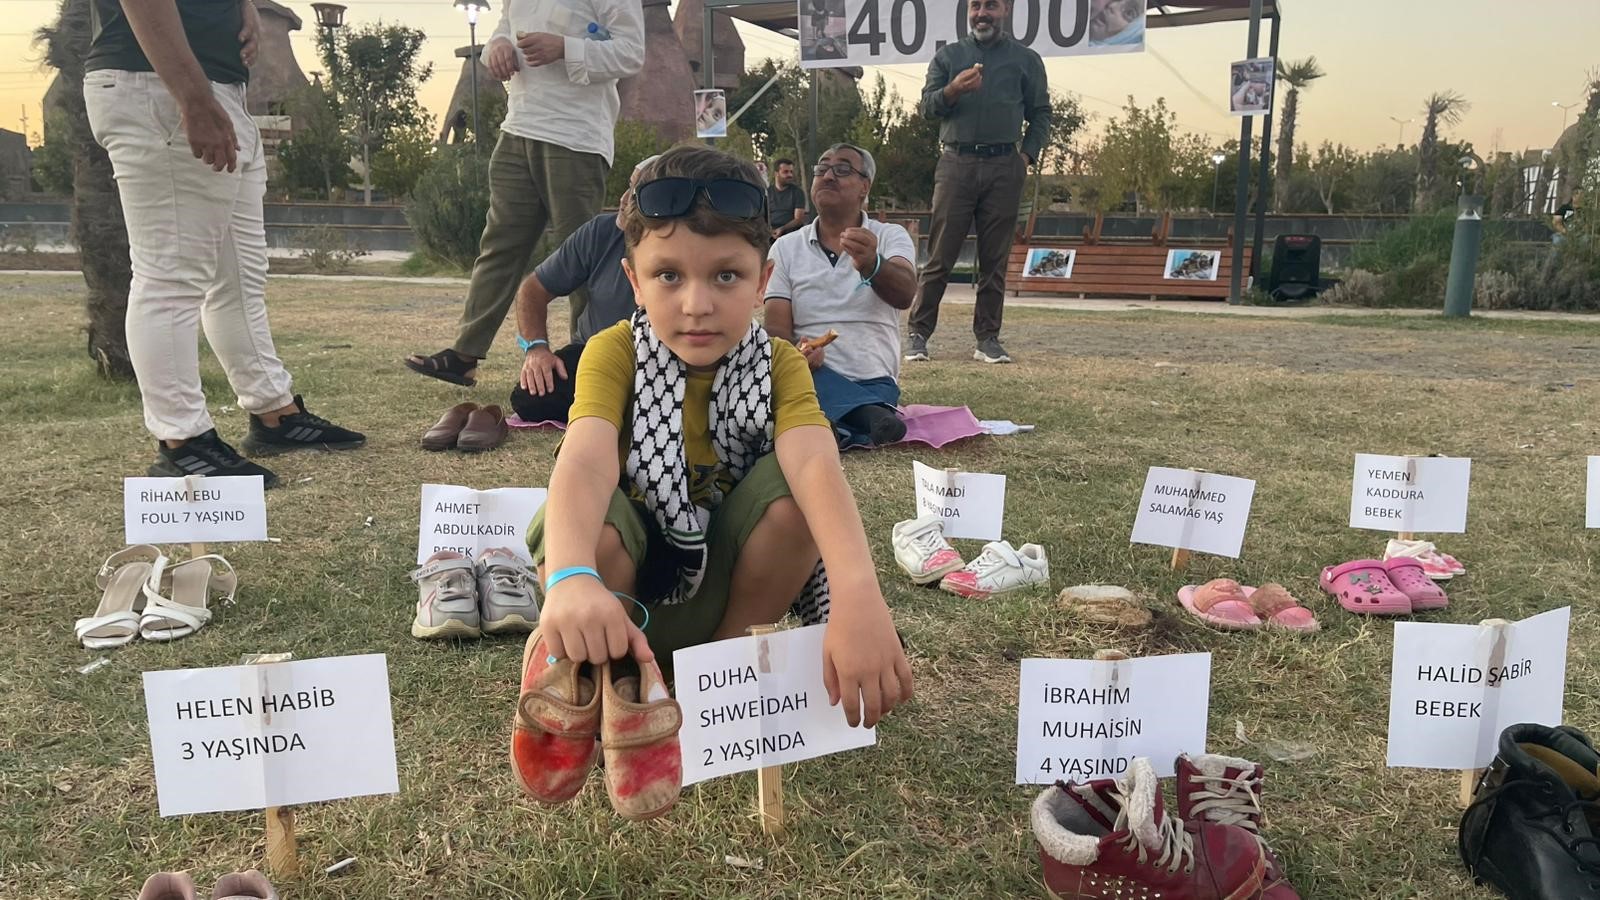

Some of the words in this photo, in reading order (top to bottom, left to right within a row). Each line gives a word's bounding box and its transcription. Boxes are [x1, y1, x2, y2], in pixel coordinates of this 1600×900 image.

[1368, 469, 1411, 482] YEMEN
[140, 488, 188, 503] RİHAM
[193, 489, 221, 501] EBU
[936, 485, 965, 498] MADİ
[1154, 484, 1226, 503] MUHAMMED
[1366, 487, 1424, 500] KADDURA
[141, 512, 179, 524] FOUL
[183, 511, 191, 523] 7
[195, 510, 245, 525] YAŞIND
[434, 502, 481, 515] AHMET
[1204, 510, 1224, 525] YAŞ
[1364, 506, 1403, 519] BEBEK
[433, 522, 515, 537] ABDULKADİR
[698, 665, 758, 692] DUHA
[1417, 663, 1482, 684] HALİD
[1488, 657, 1532, 687] ŞABİR
[176, 696, 253, 720] HELEN
[262, 686, 336, 714] HABİB
[1043, 683, 1130, 705] İBRAHİM
[700, 691, 808, 728] SHWEİDAH
[1415, 699, 1482, 718] BEBEK
[1042, 716, 1142, 739] MUHAİSİN
[181, 742, 195, 760] 3
[201, 732, 306, 761] YAŞINDA
[703, 748, 714, 766] 2
[719, 730, 806, 761] YAŞINDA
[1040, 757, 1053, 774] 4
[1058, 755, 1136, 779] YAŞIND
